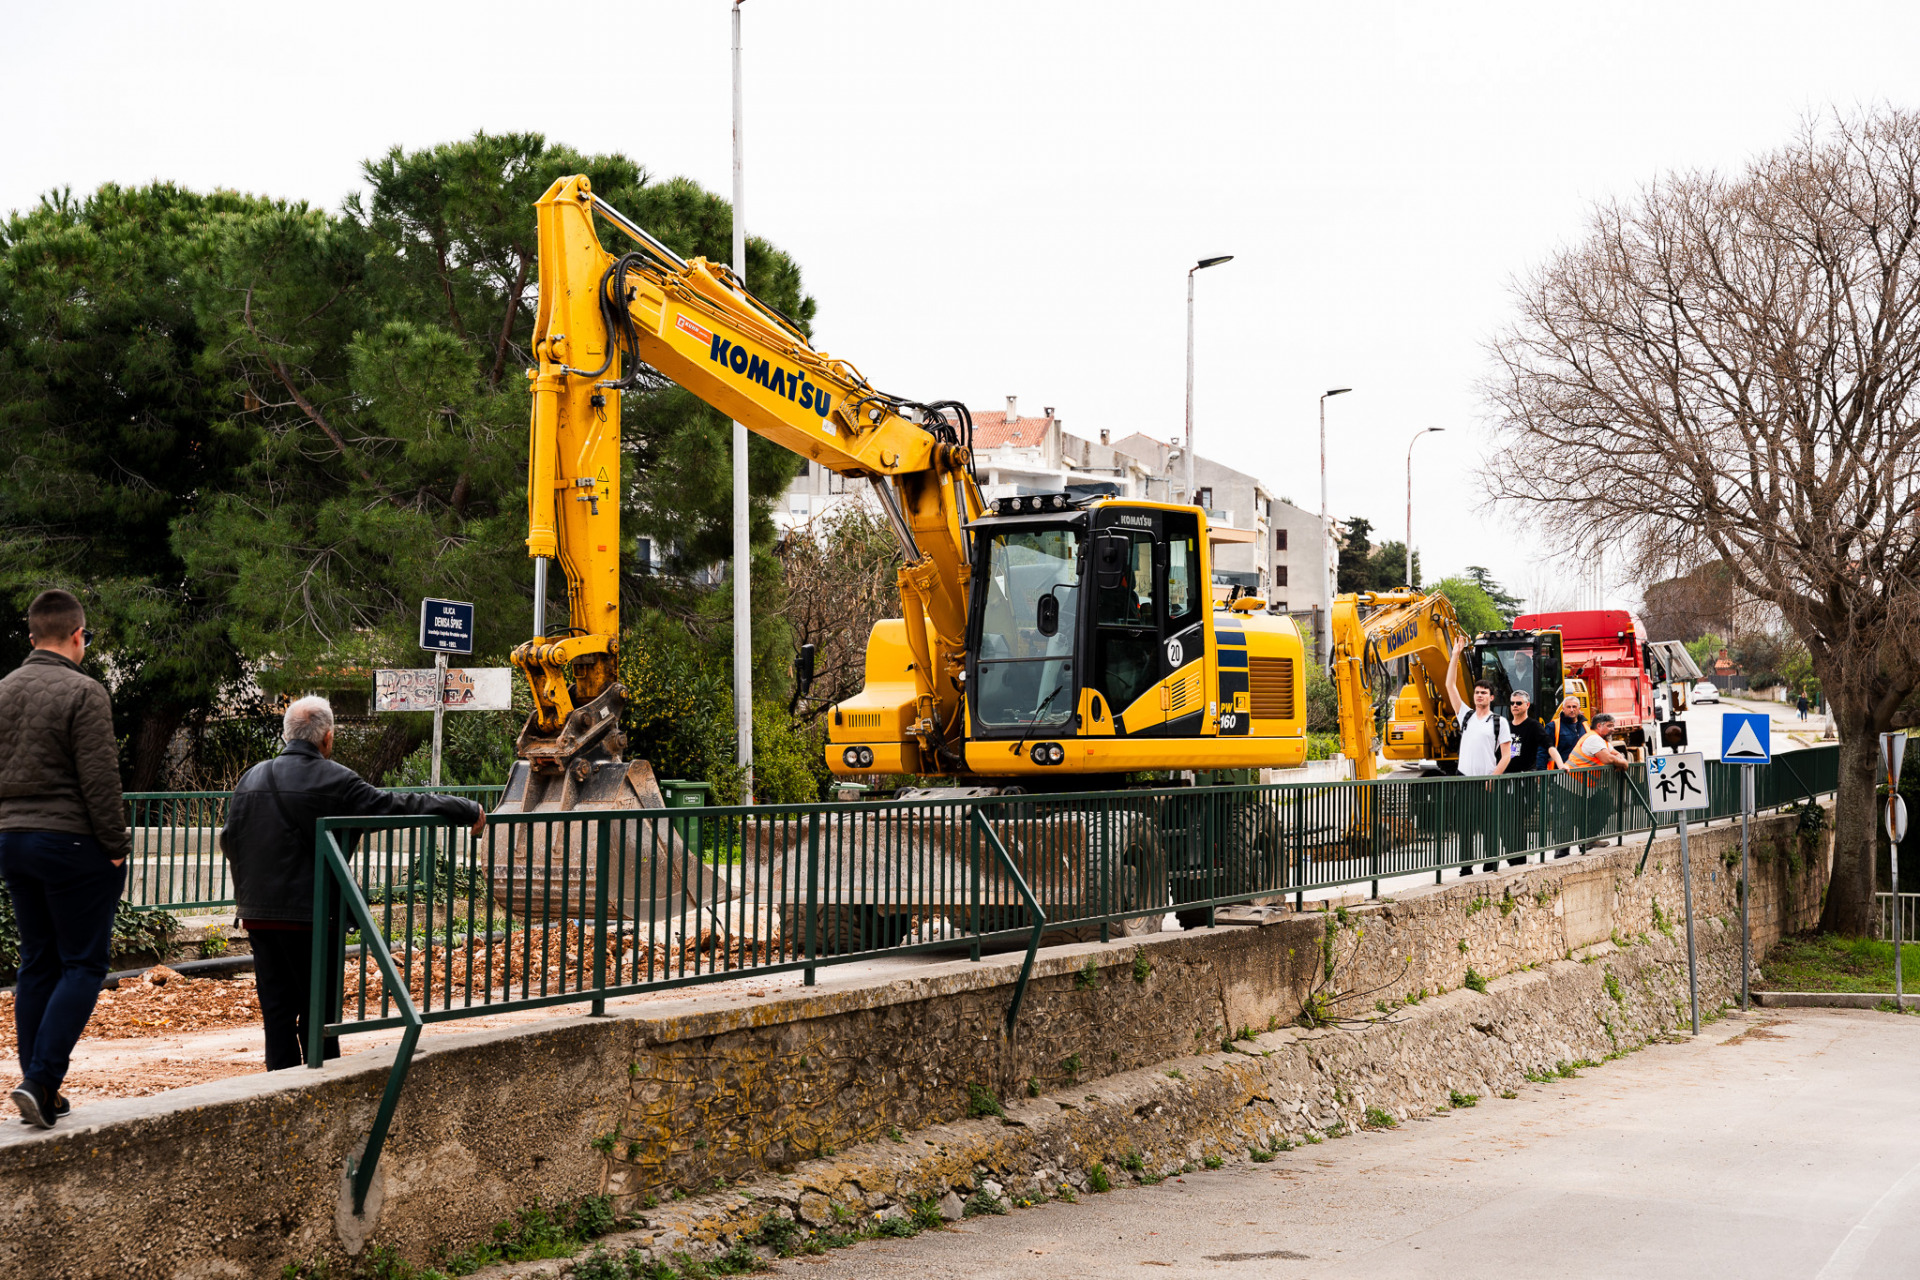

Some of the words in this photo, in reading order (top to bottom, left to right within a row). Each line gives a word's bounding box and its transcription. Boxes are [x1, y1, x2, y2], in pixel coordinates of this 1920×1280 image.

[710, 333, 832, 418] KOMATSU
[1120, 514, 1152, 527] KOMATSU
[442, 606, 456, 615] ULICA
[1386, 620, 1418, 654] KOMATSU
[1170, 644, 1180, 662] 20
[1220, 702, 1234, 713] PW
[1220, 714, 1237, 729] 160
